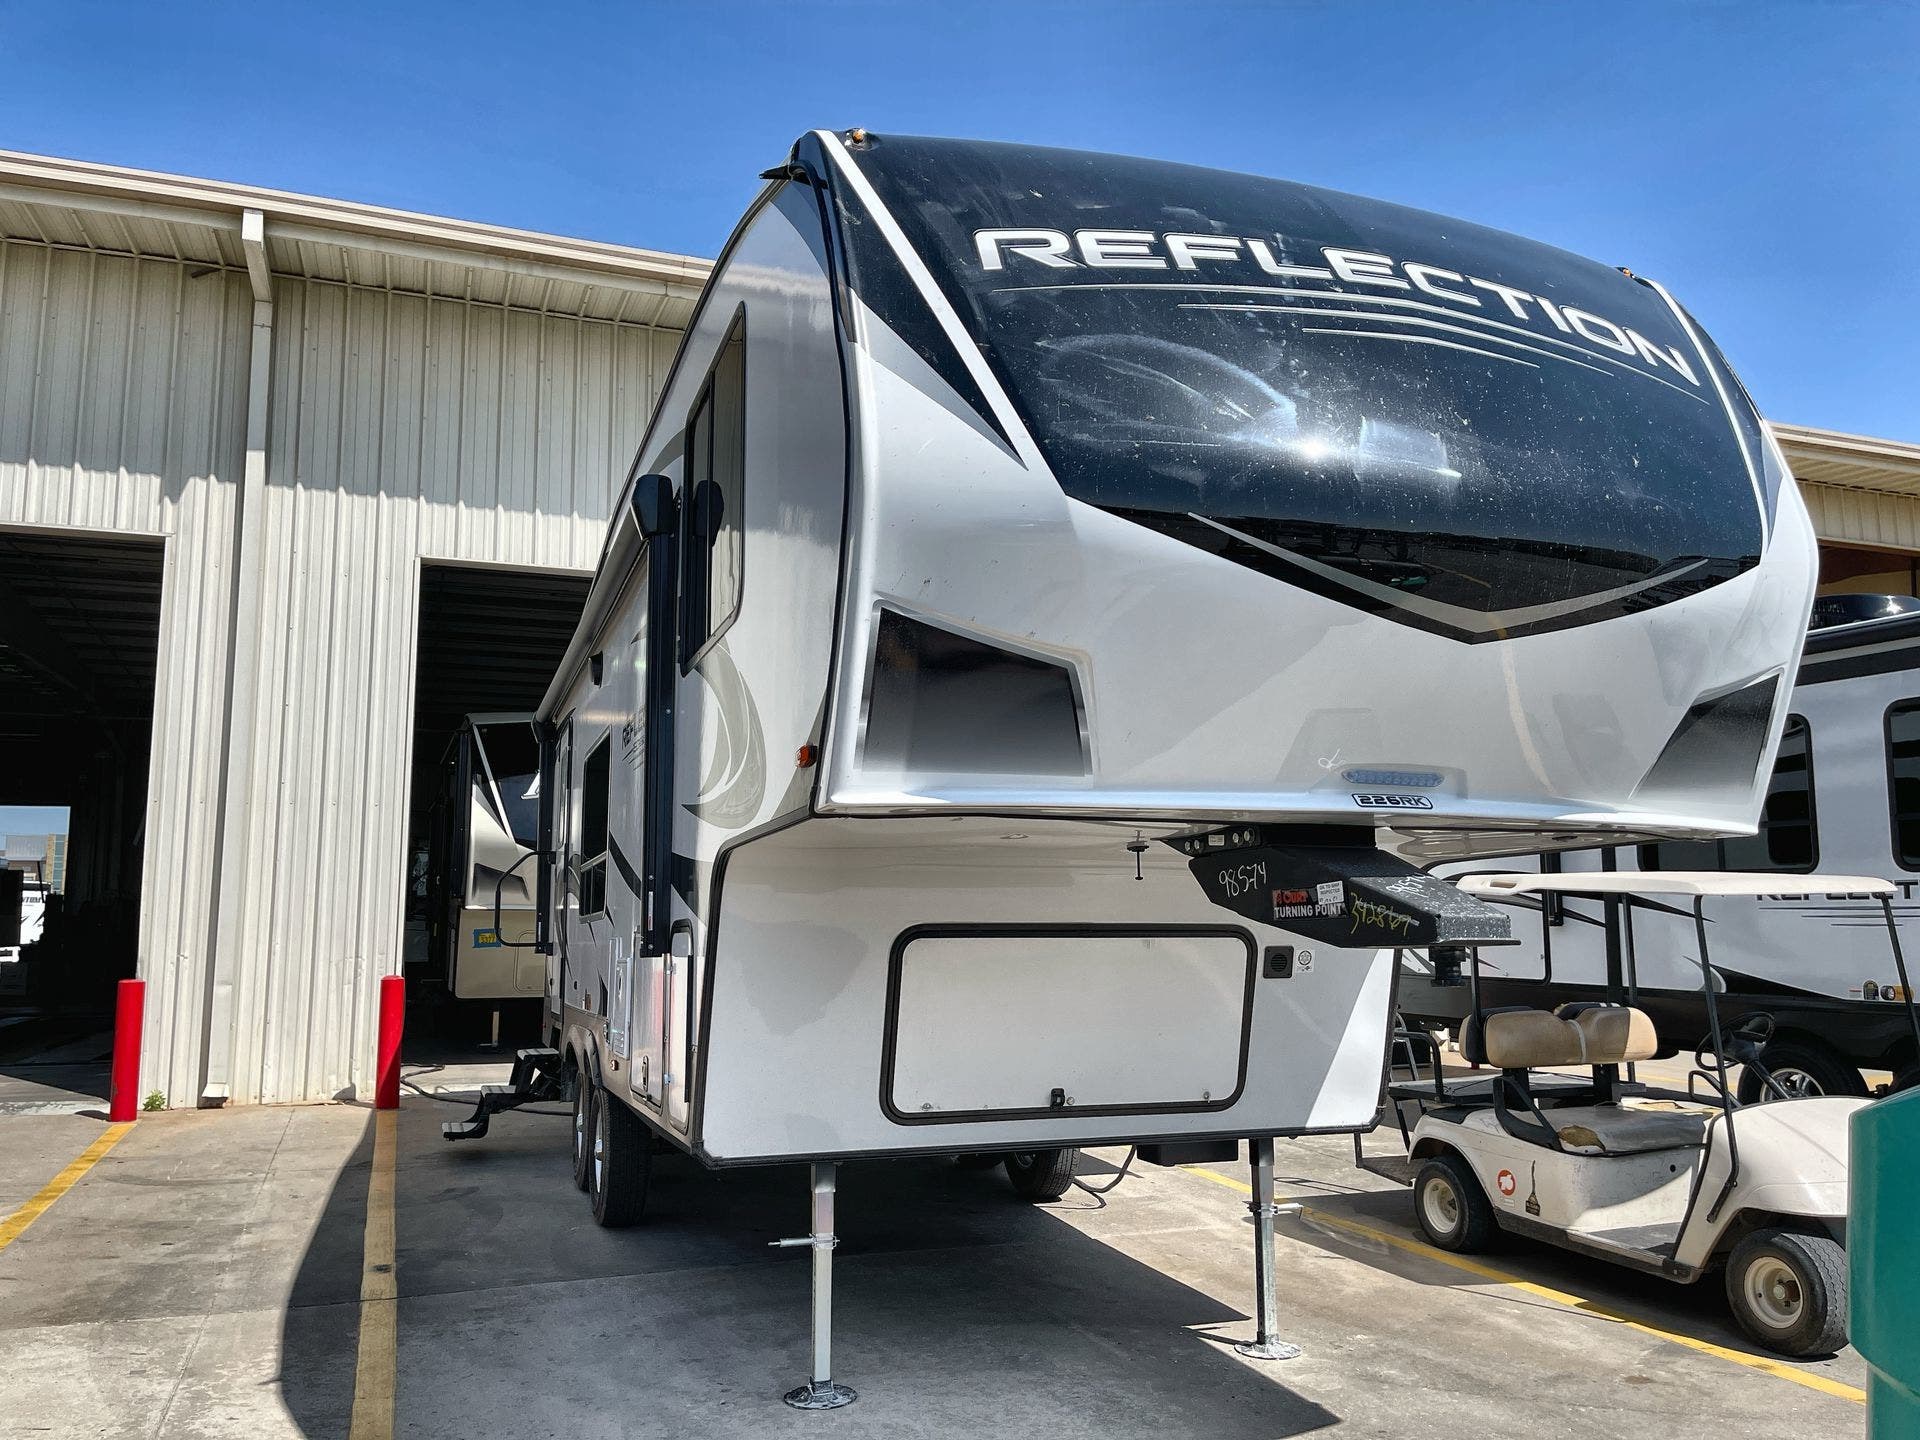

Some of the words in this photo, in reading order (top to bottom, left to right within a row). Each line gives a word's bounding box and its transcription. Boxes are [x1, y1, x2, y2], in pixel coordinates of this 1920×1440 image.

[973, 228, 1700, 386] REFLECTION
[1357, 795, 1429, 807] 226RK
[1218, 861, 1267, 898] 98574
[1274, 904, 1313, 918] TURNING
[1315, 902, 1342, 916] POINT
